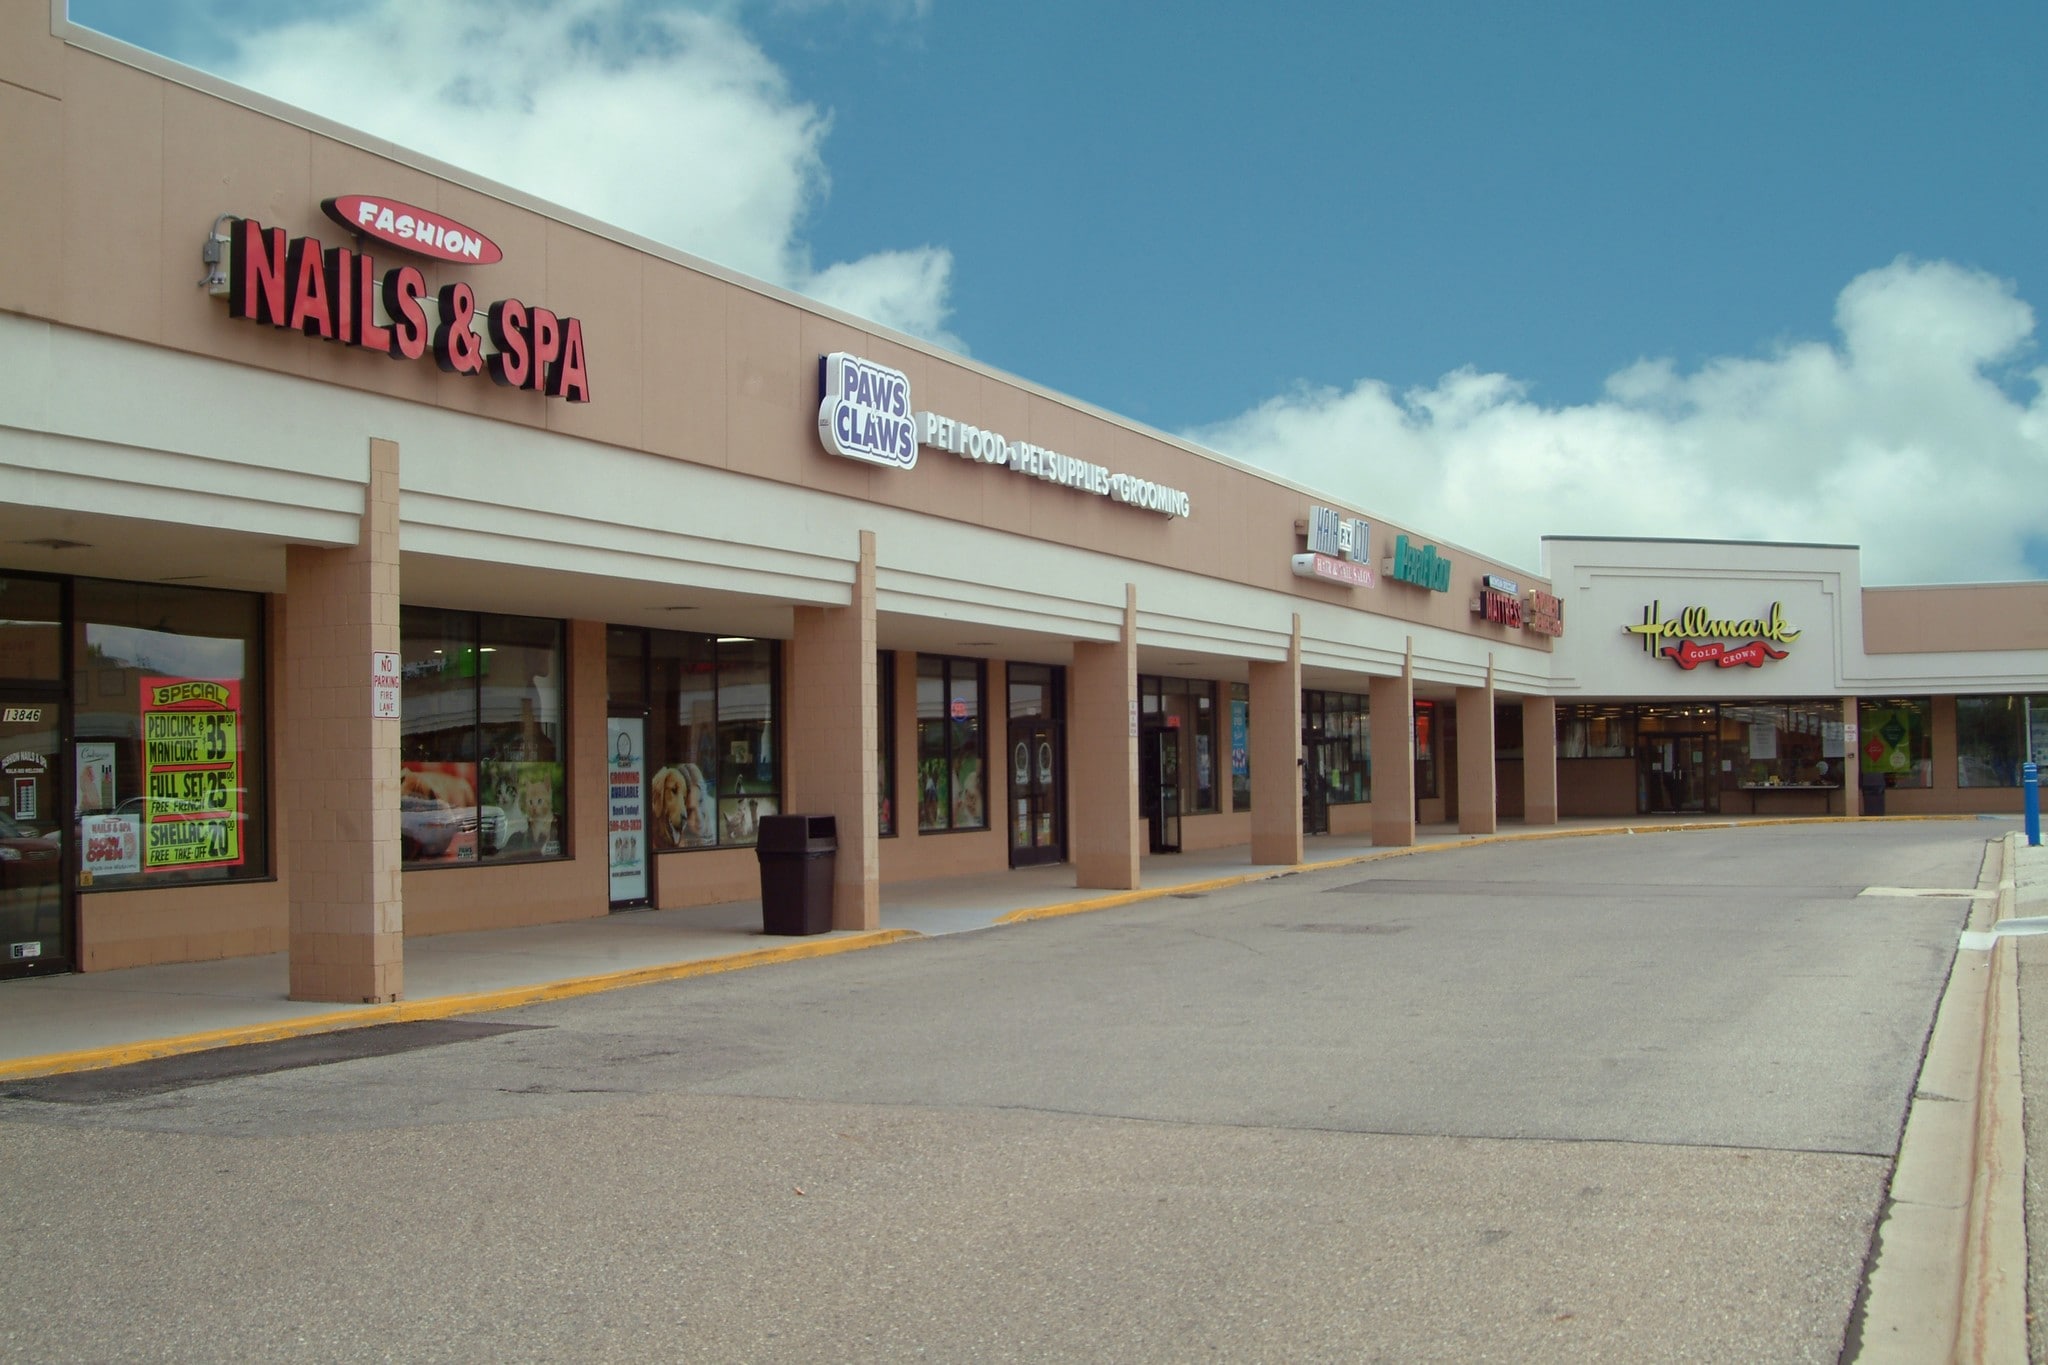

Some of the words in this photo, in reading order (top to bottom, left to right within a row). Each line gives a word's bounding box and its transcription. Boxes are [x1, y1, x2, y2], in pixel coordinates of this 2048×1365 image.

[358, 200, 482, 261] FASHION
[234, 219, 428, 360] NAILS
[437, 282, 483, 376] &
[492, 298, 591, 402] SPA
[843, 364, 906, 418] PAWS
[836, 405, 912, 458] CLAWS
[926, 411, 956, 451] PET
[959, 422, 1008, 465] FOOD
[1018, 441, 1044, 476] PET
[1047, 450, 1110, 496] SUPPLIES
[1118, 473, 1190, 518] GROOMING
[1315, 507, 1339, 555] HAIR
[1486, 591, 1521, 629] MATTRESS
[1626, 600, 1802, 658] Hallmark
[1689, 648, 1718, 659] GOLD
[1722, 649, 1757, 664] CROWN
[381, 659, 392, 672] NO
[374, 675, 399, 689] PARKING
[158, 683, 224, 704] SPECIAL
[380, 690, 393, 701] FIRE
[5, 709, 41, 721] 13846
[379, 702, 394, 712] LANE
[148, 715, 196, 738] PEDICURE
[149, 739, 199, 763] MANICURE
[150, 774, 179, 799] FULL
[183, 772, 204, 798] SET
[609, 771, 640, 785] GROOMING
[611, 785, 640, 799] AVAILABLE
[151, 800, 170, 814] FREE
[91, 824, 112, 834] NAILS
[150, 822, 205, 847] SHELLAC
[88, 837, 120, 850] NOW
[86, 848, 124, 863] OPEN
[151, 849, 170, 862] FREE
